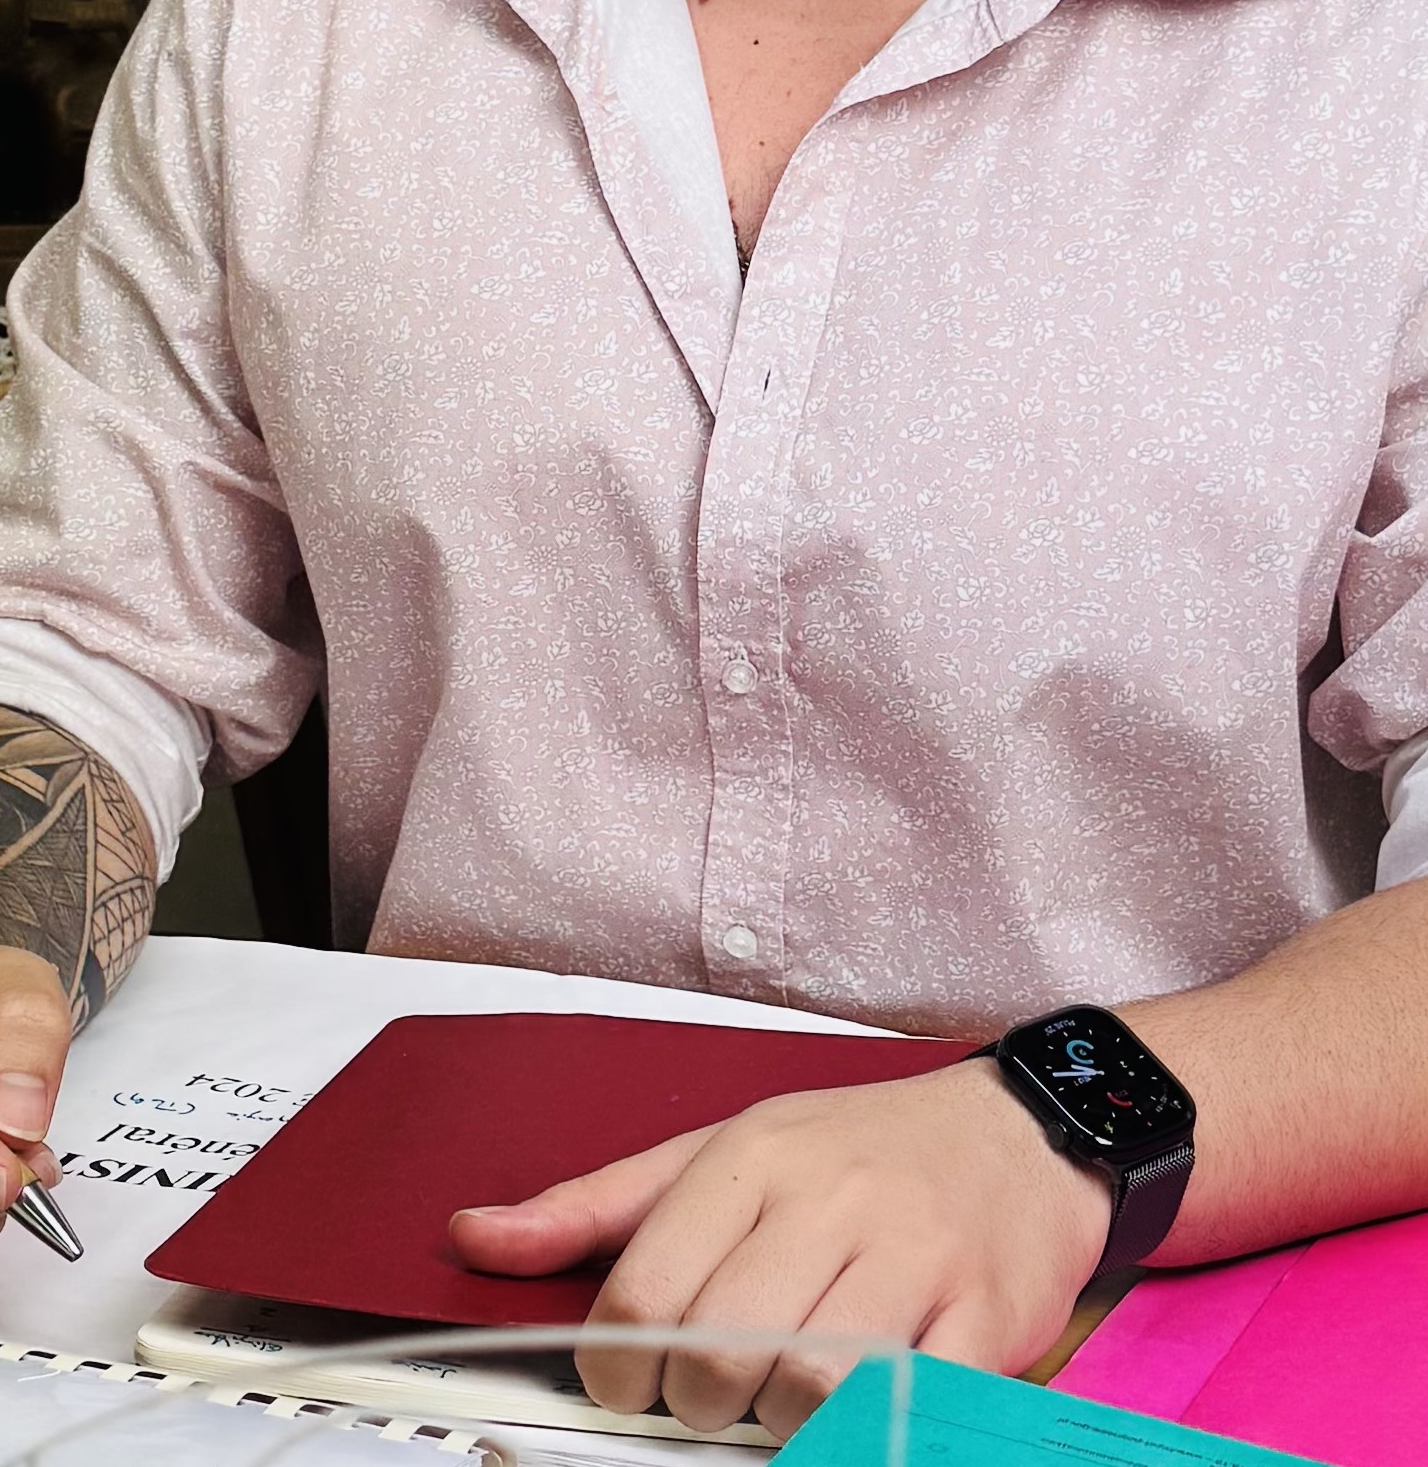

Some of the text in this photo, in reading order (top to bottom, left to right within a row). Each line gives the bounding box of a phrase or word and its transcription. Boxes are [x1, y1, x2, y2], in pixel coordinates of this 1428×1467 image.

[184, 1072, 292, 1104] 2024
[96, 1123, 261, 1161] énéral
[59, 1151, 234, 1193] INIST
